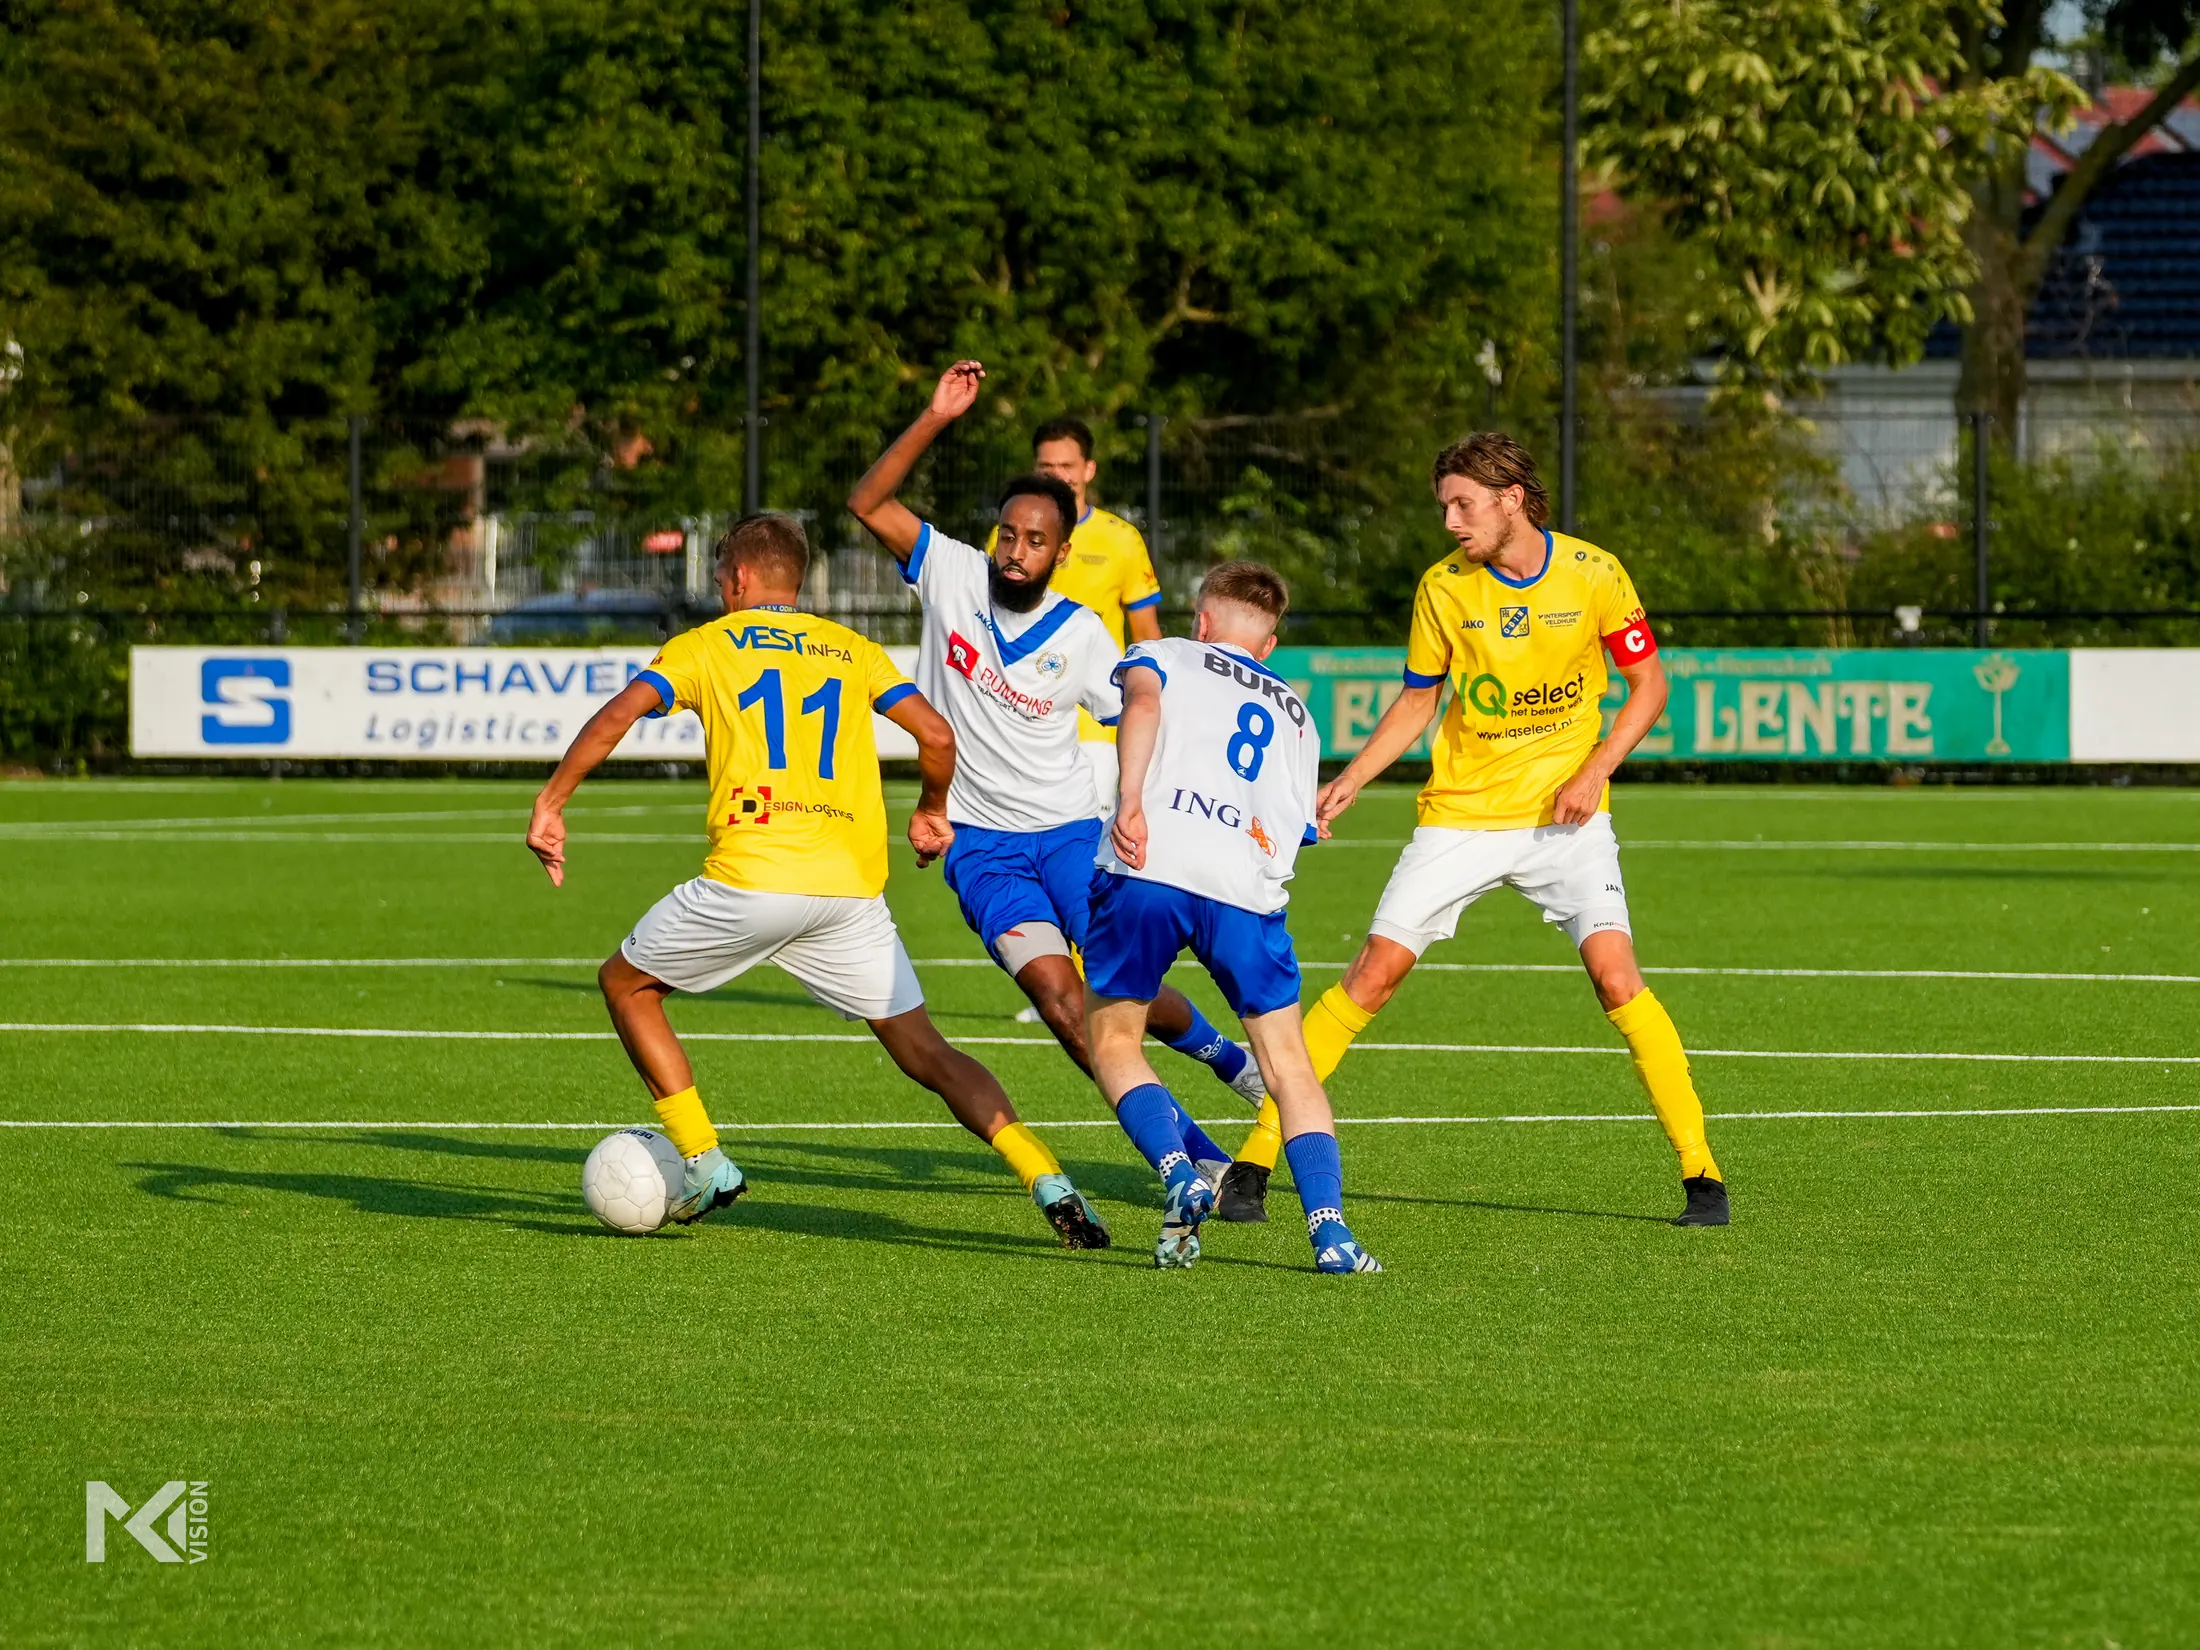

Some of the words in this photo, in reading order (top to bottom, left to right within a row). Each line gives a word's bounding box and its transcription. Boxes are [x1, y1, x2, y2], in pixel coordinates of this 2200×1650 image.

[974, 609, 993, 632] JAKO
[1461, 619, 1485, 629] JAKO
[1543, 610, 1582, 620] INTERSPORT
[1545, 617, 1577, 625] VELDHUIS
[723, 625, 807, 655] VEST
[1625, 629, 1646, 652] C
[980, 667, 1053, 716] RUMPING
[1203, 652, 1306, 728] BUKO
[1459, 672, 1508, 719] IQ
[1513, 671, 1584, 707] select
[738, 668, 842, 780] 11
[1511, 707, 1528, 717] het
[1531, 705, 1565, 717] betere
[1694, 681, 1934, 754] LENTE
[366, 715, 560, 749] Logistics
[1227, 702, 1275, 782] 8
[1477, 717, 1573, 741] www.iqselect.nl
[1168, 788, 1242, 829] ING
